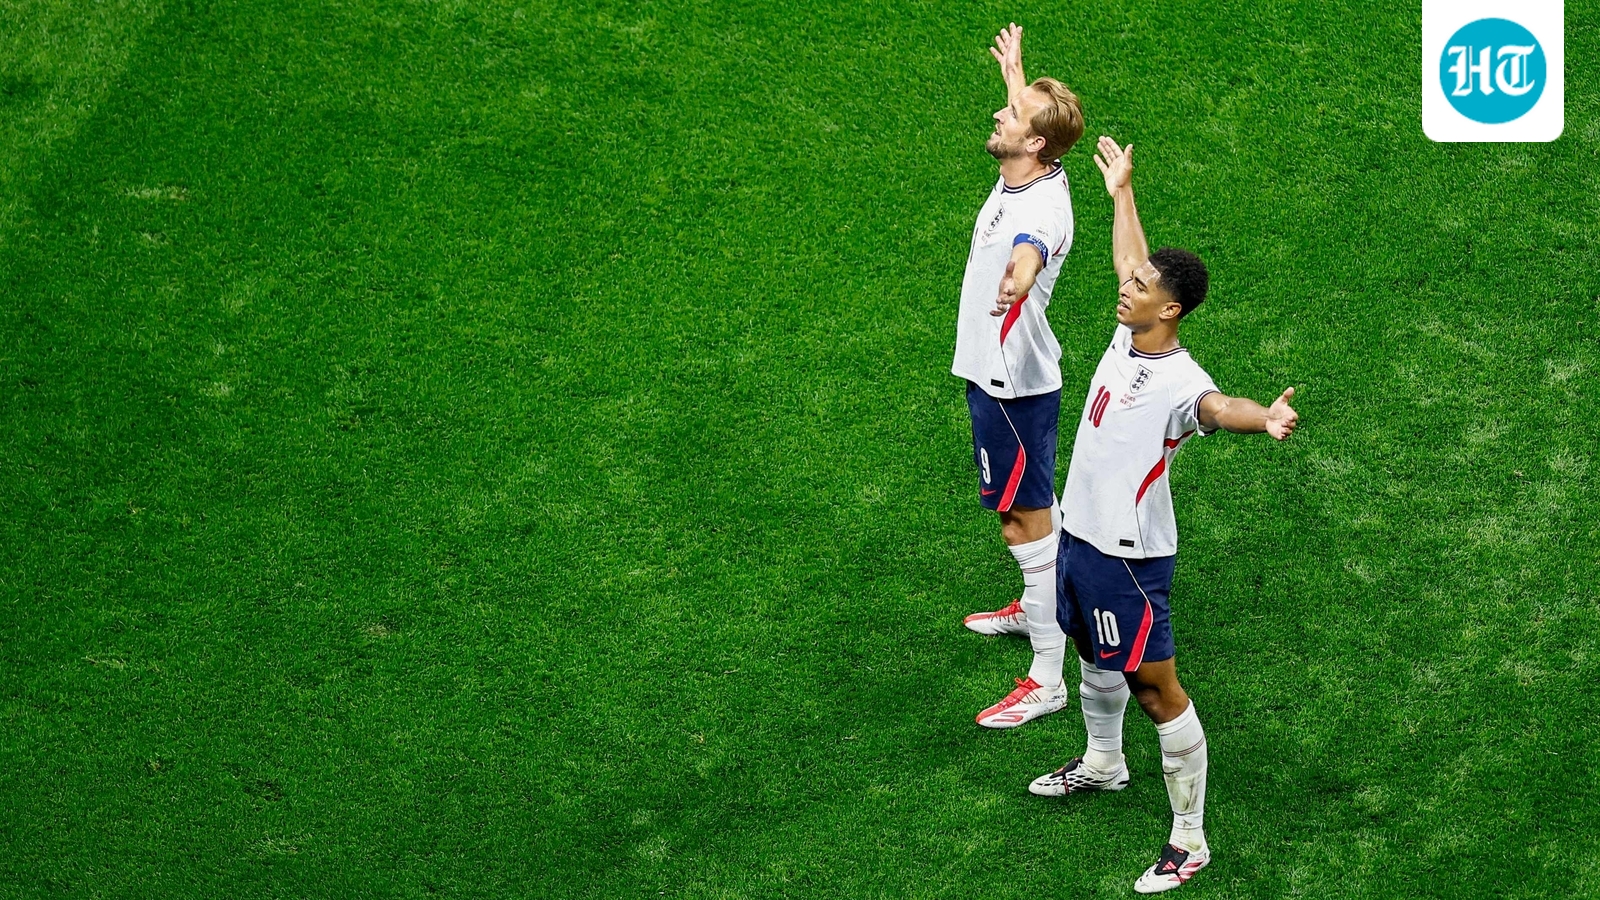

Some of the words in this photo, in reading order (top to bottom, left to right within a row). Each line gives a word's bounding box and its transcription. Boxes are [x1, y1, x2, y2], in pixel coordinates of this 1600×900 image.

[1088, 385, 1111, 428] 10
[980, 447, 991, 485] 9
[1093, 607, 1121, 647] 10
